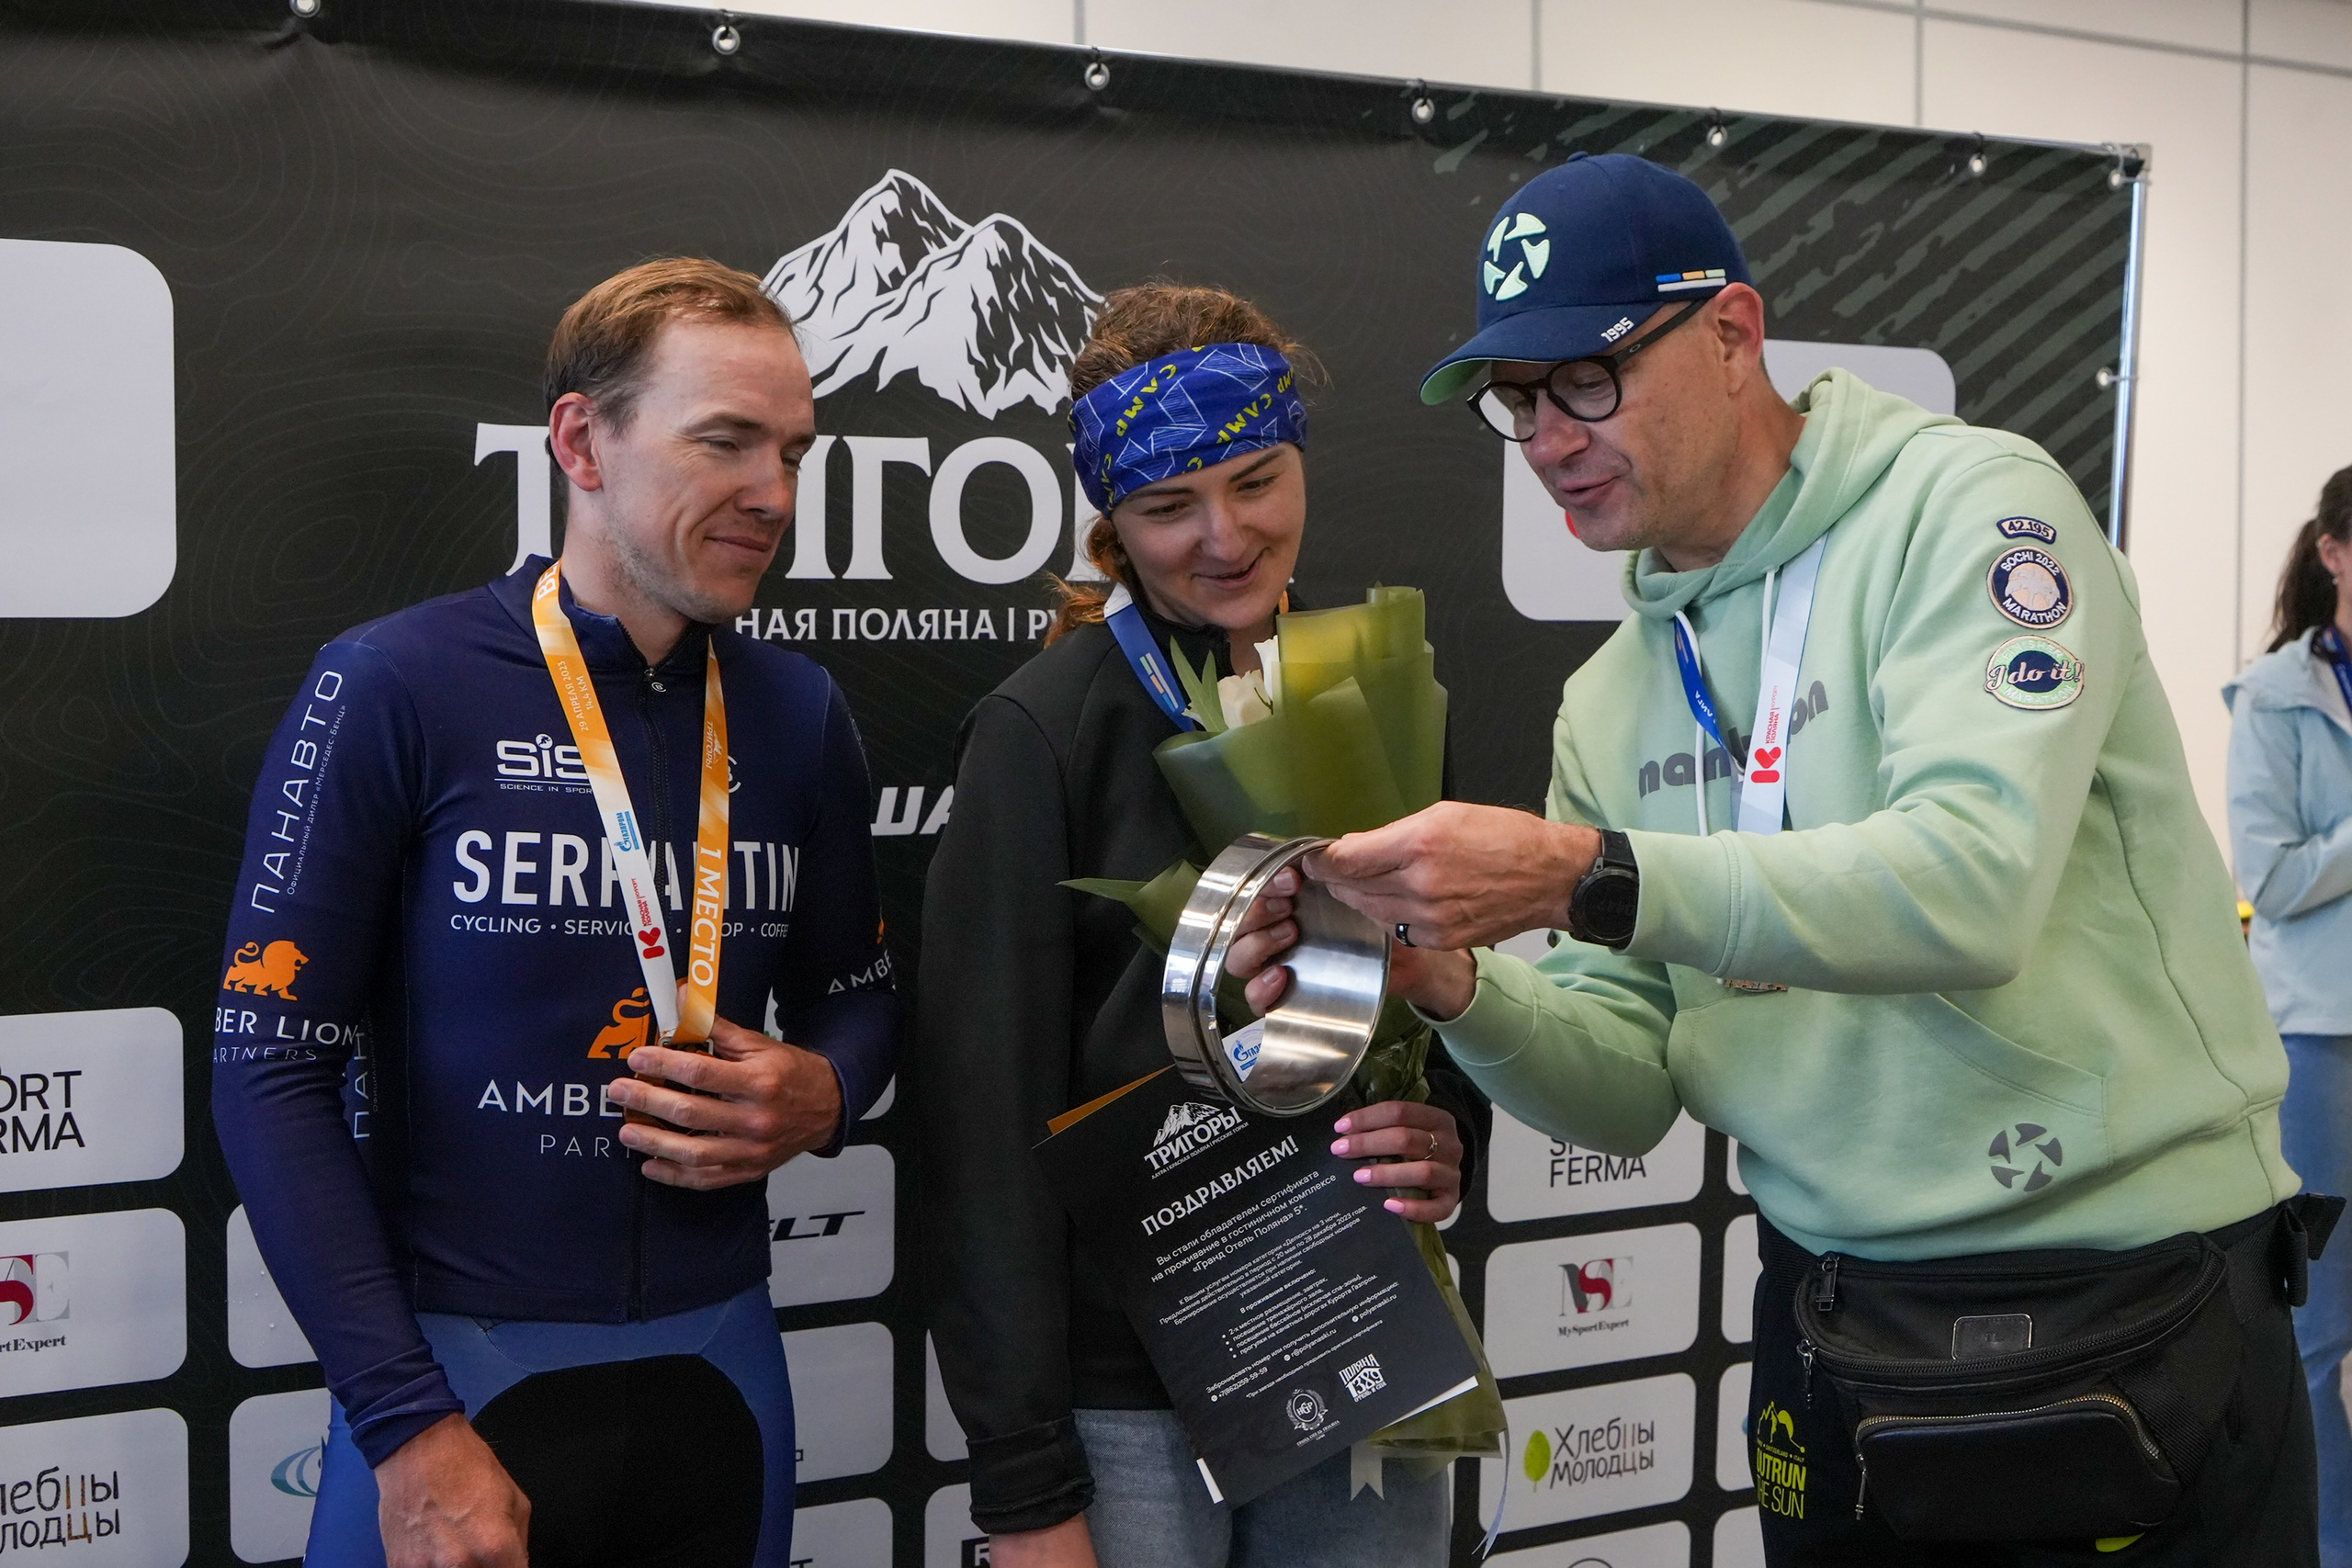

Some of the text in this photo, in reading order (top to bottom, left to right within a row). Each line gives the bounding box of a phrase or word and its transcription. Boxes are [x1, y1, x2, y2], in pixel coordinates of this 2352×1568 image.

[1600, 316, 1635, 344] 1995
[1115, 363, 1178, 438] CAMP
[1216, 392, 1272, 445] CAMP
[2008, 520, 2051, 538] 42.195
[2000, 551, 2060, 577] SOCHI 2022
[831, 607, 999, 641] ПОЛЯНА
[2002, 596, 2067, 625] MARATHON
[2003, 640, 2064, 660] FINISHER
[2008, 661, 2042, 684] do
[2050, 660, 2085, 682] it!
[557, 660, 589, 732] 29 АПРЕЛЯ 2023
[576, 676, 593, 712] 14.4 КМ
[2005, 684, 2075, 705] MARATHON
[702, 721, 714, 770] ТРИГОРЫ
[1765, 711, 1775, 744] КРАСНАЯ
[1770, 713, 1780, 744] ПОЛЯНА
[496, 734, 589, 780] SiS
[251, 671, 343, 913] ПАНАВТО
[500, 784, 543, 792] SCIENCE
[616, 812, 630, 840] ГАЗПРОМ
[453, 829, 799, 912] SERATIN
[450, 915, 634, 936] CYCLING SERVIC
[692, 847, 722, 987] 1 МЕСТО
[277, 1015, 358, 1045] LION
[1143, 1105, 1243, 1170] ТРИГОРЫ
[1151, 1122, 1250, 1180] ЛАУРА КРАСНАЯ ПОЛЯНА РУССКИЕ ГОРКИ
[1140, 1134, 1299, 1236] ПОЗДРАВЛЯЕМ!
[1550, 1155, 1646, 1188] FERMA
[1150, 1174, 1337, 1283] на проживание в гостиничном комплексе
[1156, 1170, 1319, 1266] Вы стали обладателем сертификата
[1183, 1288, 1206, 1303] Вашим
[1204, 1274, 1230, 1292] услугам
[1229, 1261, 1253, 1277] номера
[1251, 1245, 1283, 1265] категории
[1282, 1228, 1312, 1247] «Делюкс»
[1324, 1212, 1341, 1224] ночи.
[1193, 1251, 1227, 1273] «Гранд
[1224, 1235, 1255, 1254] Отель
[1253, 1213, 1294, 1238] Поляна»
[1159, 1299, 1201, 1325] Предложение
[1200, 1274, 1245, 1303] действительно
[1249, 1259, 1272, 1275] период
[1274, 1251, 1284, 1260] 20
[1283, 1245, 1296, 1255] мая
[1295, 1240, 1305, 1248] по
[1303, 1235, 1313, 1244] 28
[1312, 1222, 1338, 1240] декабря
[1336, 1213, 1352, 1225] 2023
[1351, 1205, 1368, 1217] года.
[1173, 1217, 1361, 1325] Бронирование осуществляется при наличии свободных номеров
[1238, 1259, 1303, 1299] указанной категории.
[1228, 1277, 1329, 1336] 2-х местное размещение, завтрак,
[1245, 1286, 1284, 1311] проживание
[1283, 1268, 1317, 1290] включено:
[1359, 1293, 1397, 1320] polyanaski.ru
[1232, 1288, 1324, 1342] посещение тренажёрного зала,
[1236, 1273, 1363, 1348] посещение бассейнов (исключая спа-зоны),
[1239, 1337, 1268, 1355] прогулки
[1275, 1315, 1305, 1335] канатных
[1303, 1302, 1329, 1320] дорогах
[1327, 1289, 1352, 1305] Курорта
[1351, 1274, 1378, 1292] Газпром.
[1558, 1319, 1630, 1337] MySportExpert
[1205, 1280, 1399, 1393] Забронировать номер или получить дополнительную информацию:
[1290, 1328, 1337, 1358] r@polyanaski.ru
[1218, 1366, 1268, 1398] +7(862)259-59-59
[1338, 1353, 1380, 1386] ПОЛЯНА
[1345, 1367, 1385, 1398] 1389
[1793, 1454, 1805, 1463] ITALY
[1771, 1485, 1804, 1519] SUN
